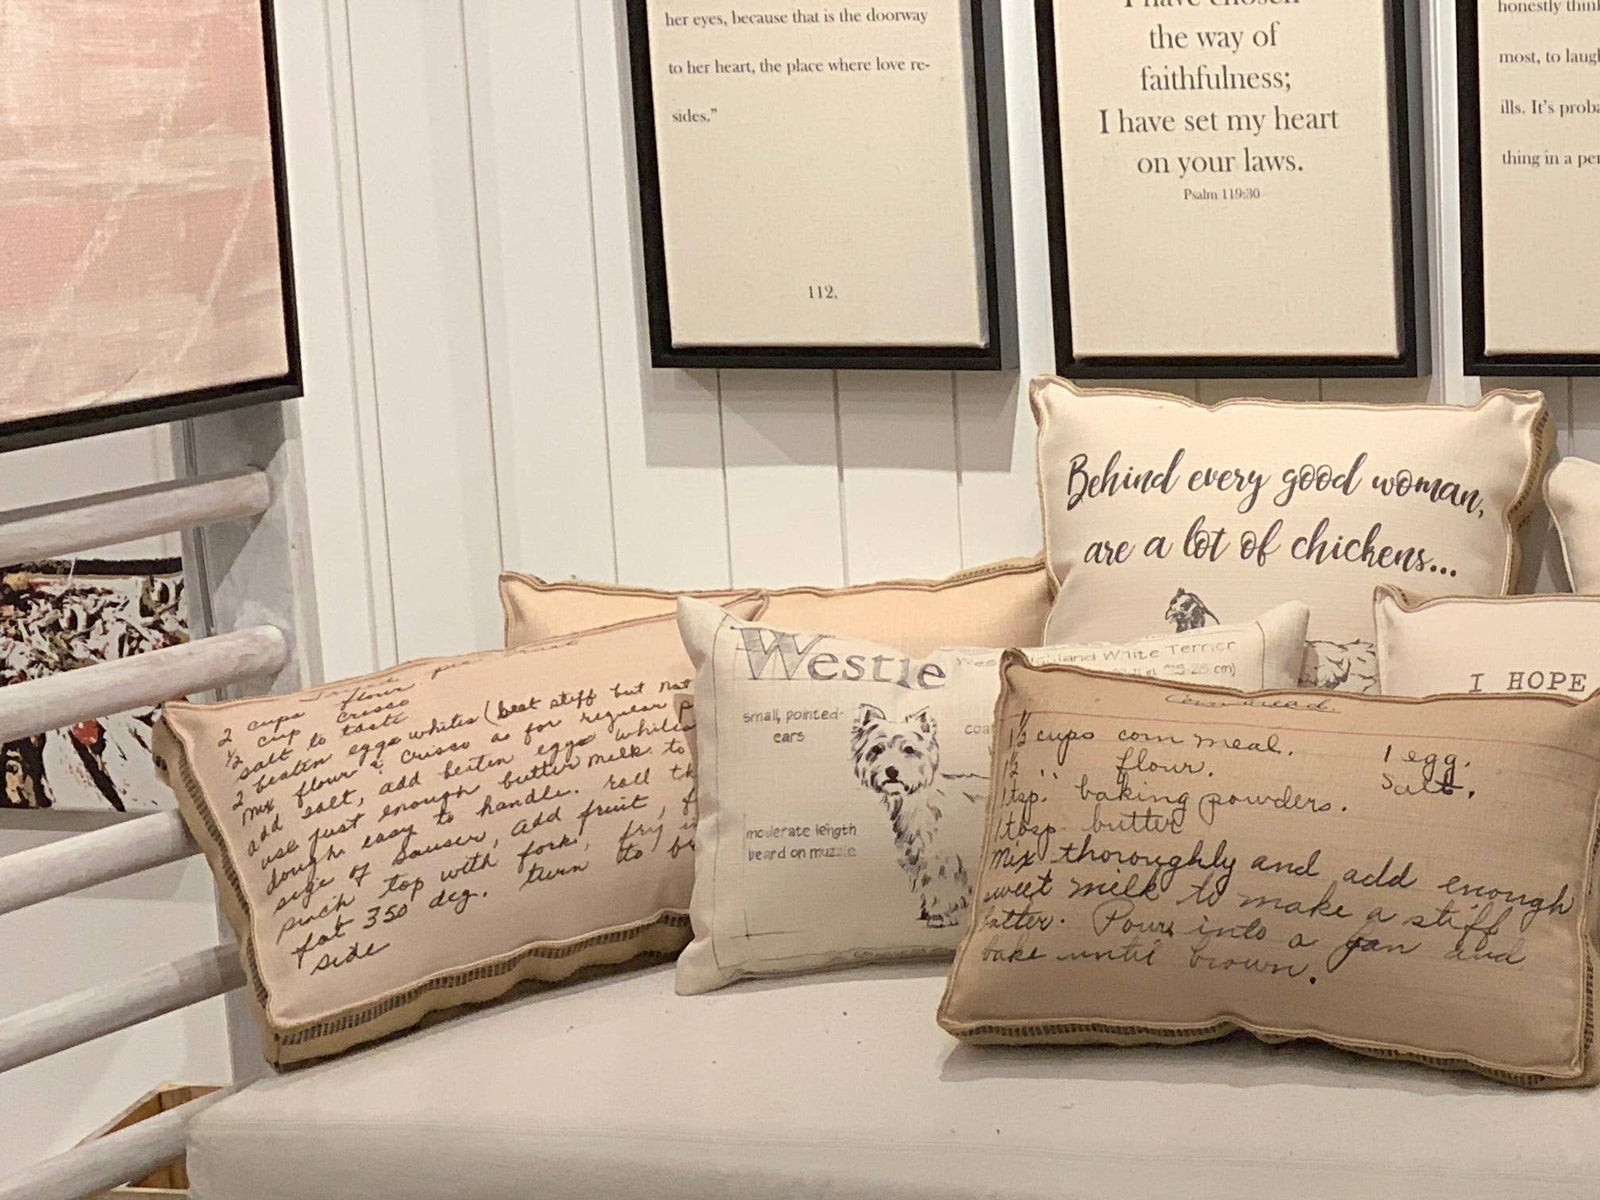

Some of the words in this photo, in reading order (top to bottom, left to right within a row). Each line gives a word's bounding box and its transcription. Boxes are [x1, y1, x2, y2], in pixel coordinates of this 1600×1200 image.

[664, 11, 689, 27] her
[692, 15, 728, 29] eyes,
[731, 9, 788, 25] because
[792, 8, 820, 24] that
[823, 8, 836, 23] is
[839, 7, 862, 23] the
[865, 6, 928, 25] doorway
[1149, 23, 1189, 50] the
[1196, 30, 1245, 55] way
[1252, 20, 1281, 48] of
[668, 63, 683, 75] to
[686, 59, 711, 75] her
[714, 58, 756, 75] heart,
[759, 57, 782, 73] the
[786, 57, 824, 76] place
[827, 56, 872, 72] where
[876, 56, 906, 72] love
[910, 60, 931, 72] re-
[1499, 51, 1541, 65] most,
[1545, 51, 1562, 64] to
[1140, 63, 1292, 93] faithfulness;
[1500, 98, 1526, 115] ills.
[1531, 99, 1555, 115] It's
[1096, 108, 1112, 135] I
[1117, 107, 1176, 134] have
[1184, 111, 1219, 132] set
[1226, 113, 1267, 138] my
[1273, 104, 1340, 131] heart
[1136, 156, 1171, 174] on
[1177, 155, 1237, 180] your
[1243, 146, 1304, 173] laws.
[1502, 149, 1541, 168] thing
[1544, 149, 1560, 166] in
[1563, 154, 1573, 165] a
[1183, 187, 1219, 201] Psalm
[1222, 187, 1261, 201] 119:30
[808, 284, 838, 300] 112.
[1066, 447, 1186, 512] Behind
[1187, 466, 1272, 515] every
[1272, 451, 1369, 508] good
[1371, 468, 1485, 520] woman,
[1083, 539, 1136, 567] are
[1143, 535, 1175, 560] a
[1182, 514, 1232, 563] lot
[1239, 518, 1284, 568] of
[1290, 516, 1457, 578] chickens...
[730, 626, 947, 691] Westie
[1469, 674, 1485, 692] I
[1505, 671, 1589, 693] HOPE
[742, 708, 781, 725] small,
[772, 730, 806, 744] ears
[1075, 774, 1190, 826] baking
[1198, 784, 1349, 827] powders.
[1048, 833, 1237, 896] thoroughly
[1250, 848, 1320, 878] and
[1342, 855, 1418, 890] add
[1436, 873, 1577, 934] enough
[362, 904, 409, 930] 350
[308, 940, 392, 976] side
